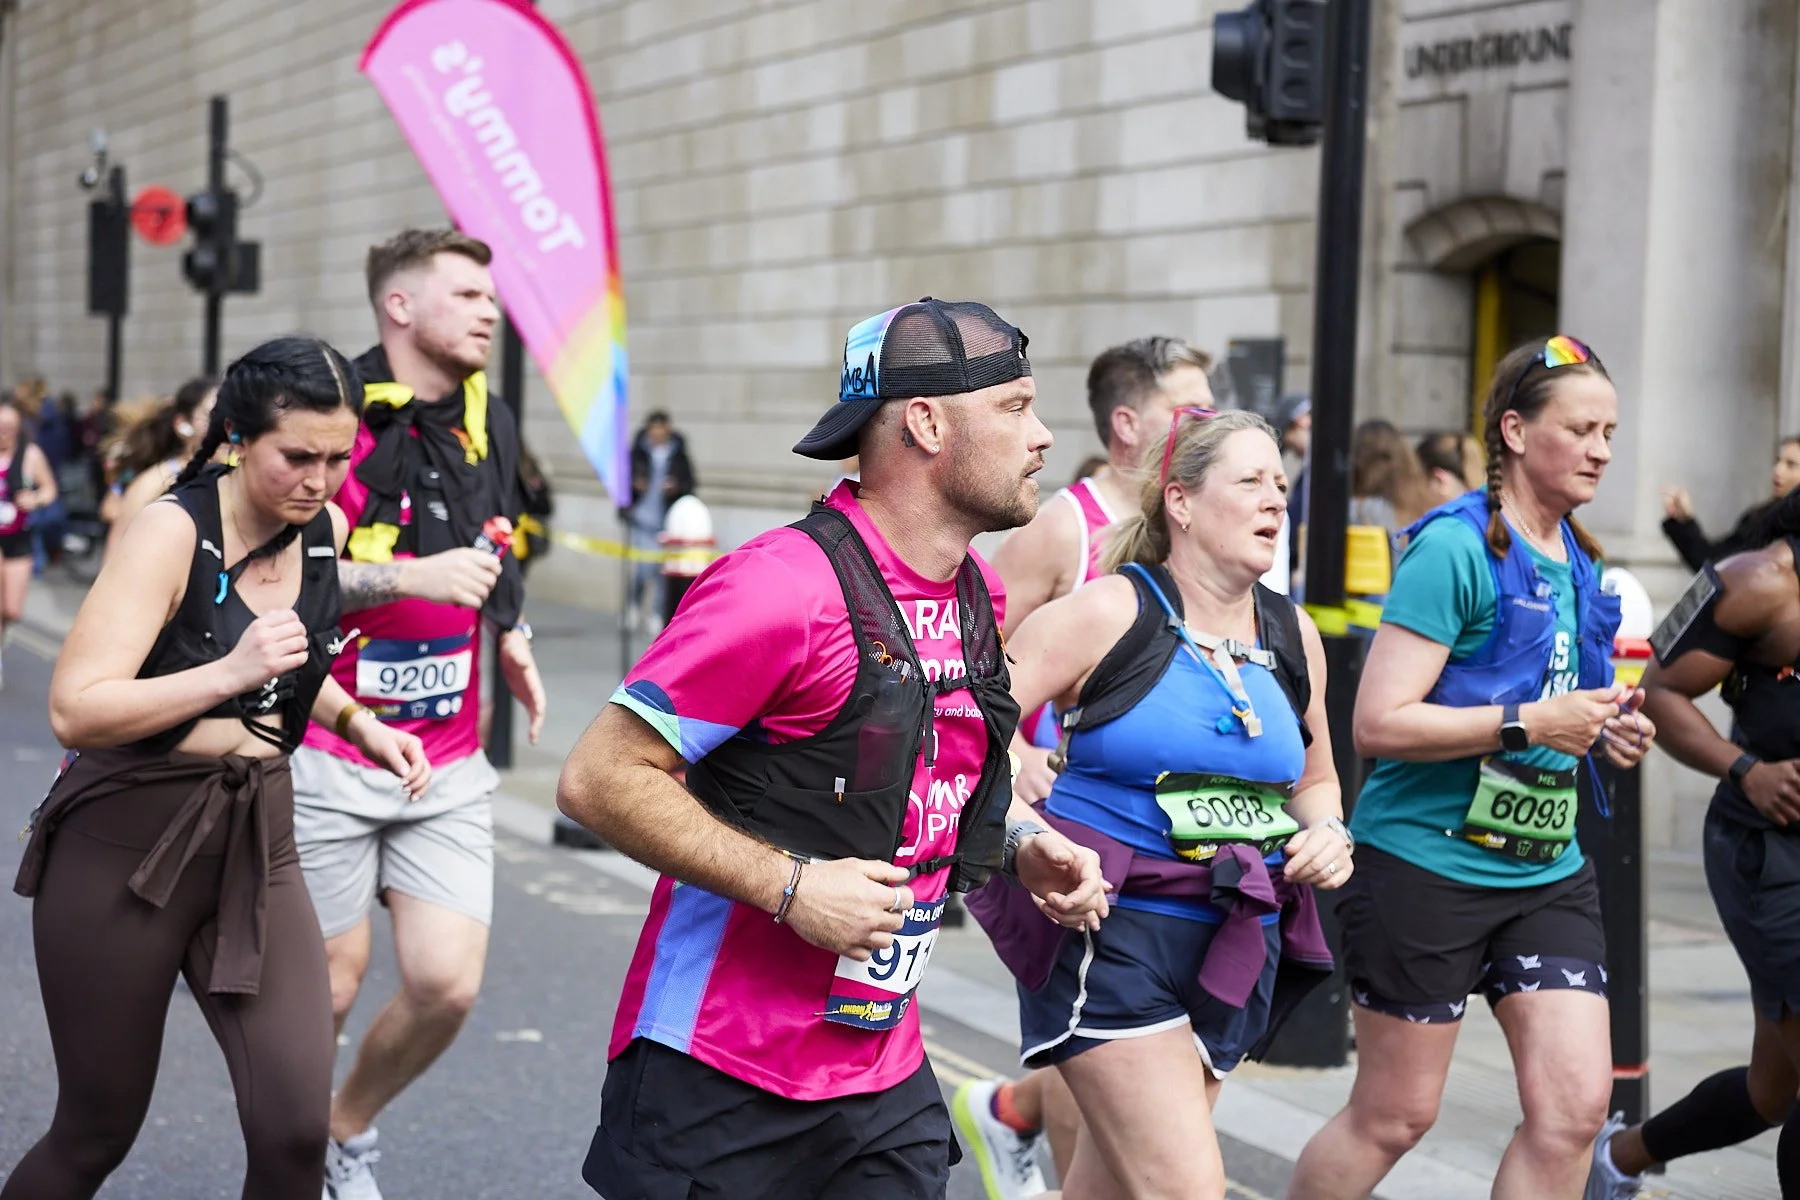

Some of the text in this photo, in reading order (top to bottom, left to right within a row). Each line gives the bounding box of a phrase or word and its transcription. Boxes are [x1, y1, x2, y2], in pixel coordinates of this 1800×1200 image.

[379, 661, 457, 694] 9200
[944, 704, 963, 717] and
[1537, 772, 1557, 787] MEL
[1187, 794, 1274, 828] 6088
[1490, 790, 1569, 831] 6093
